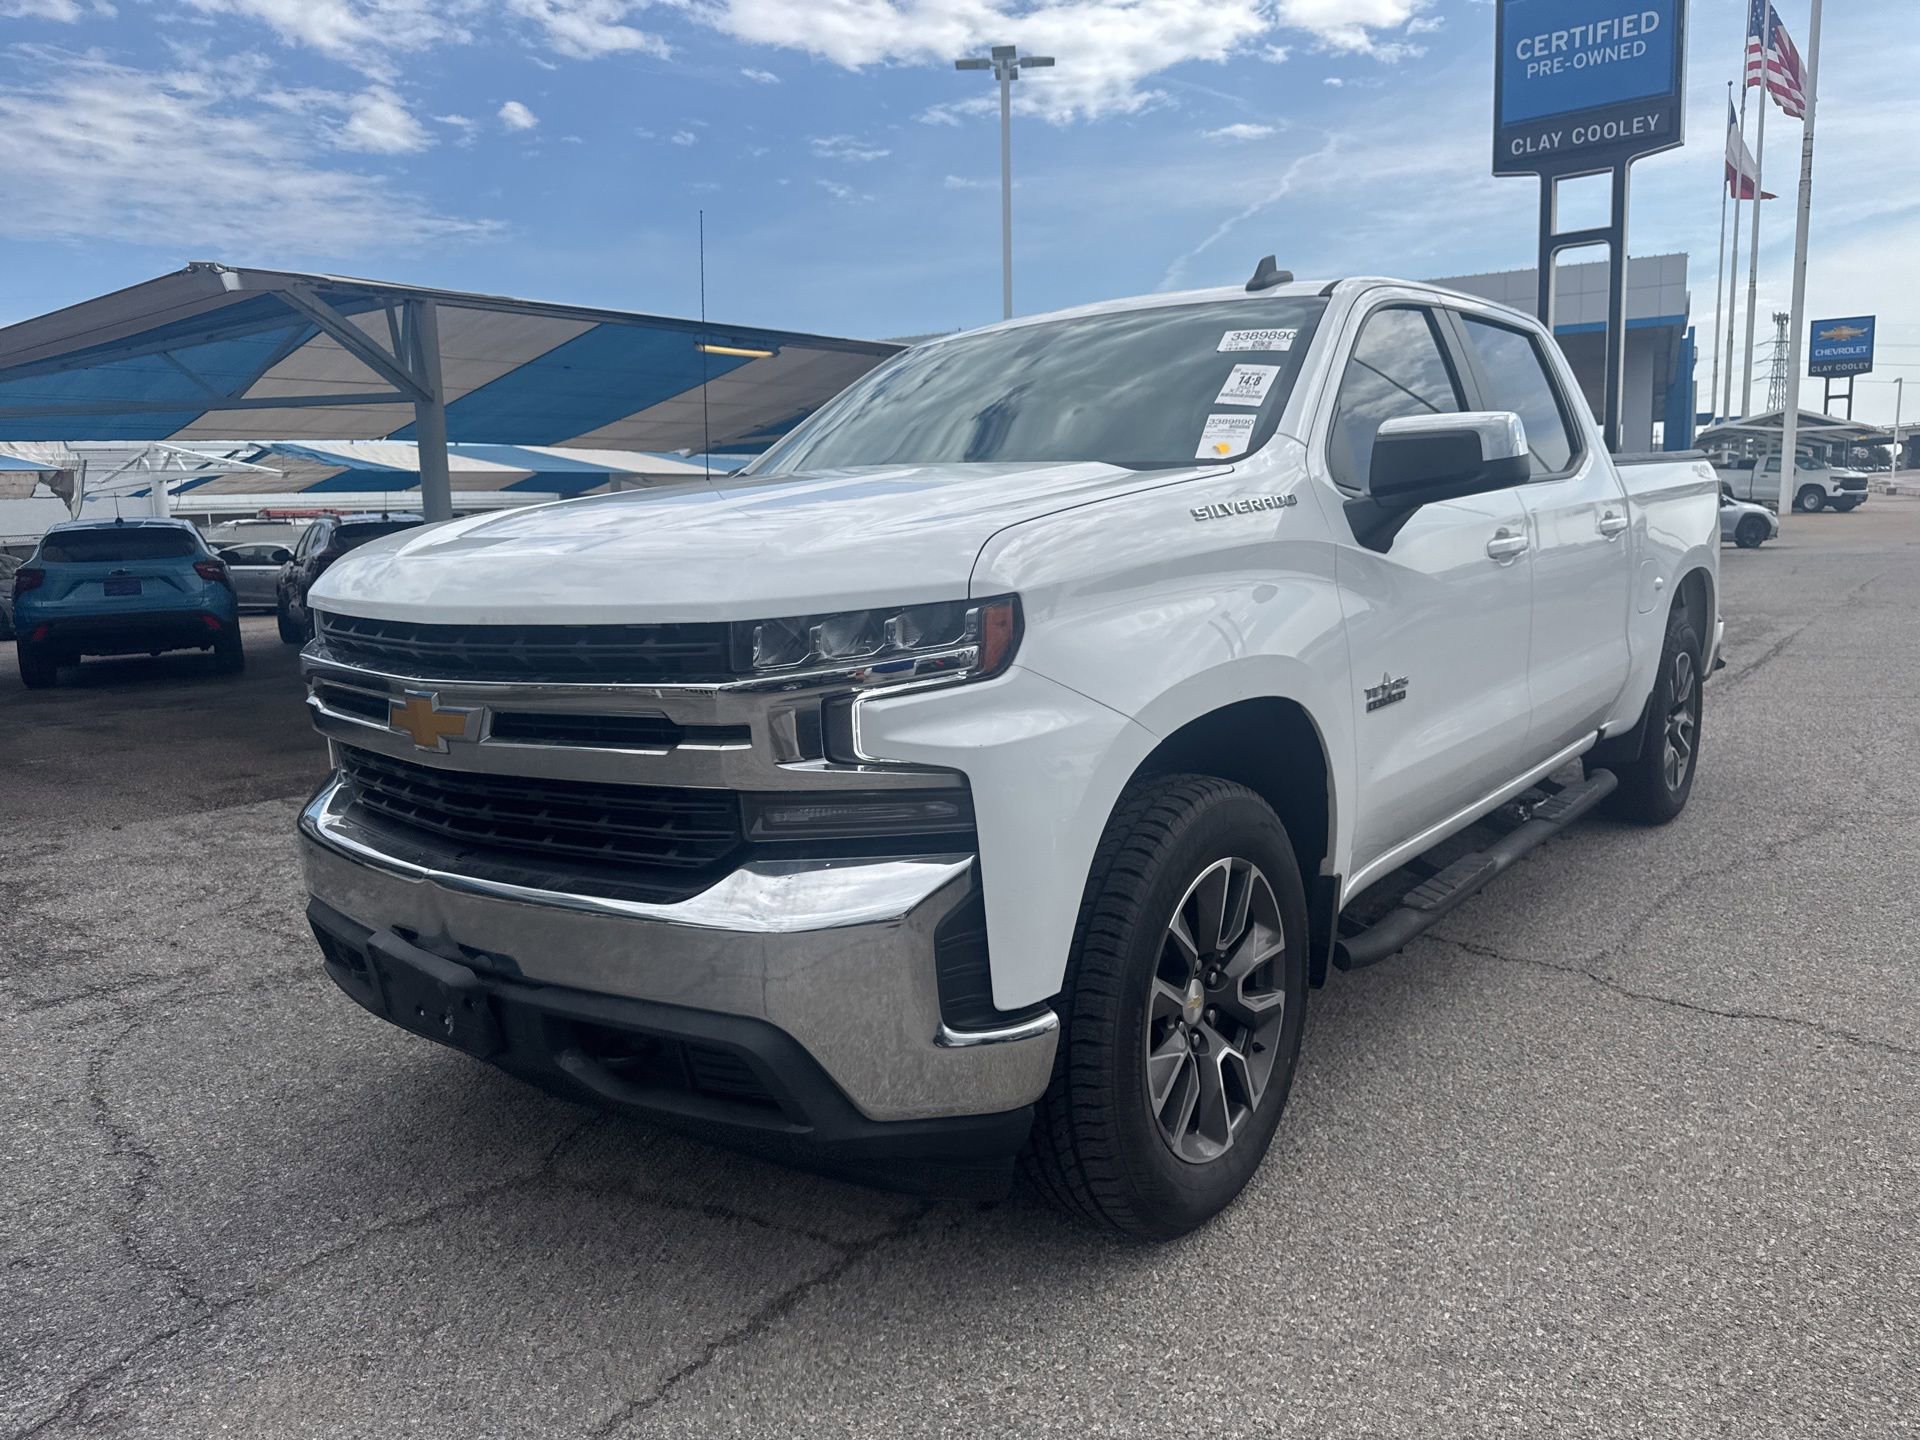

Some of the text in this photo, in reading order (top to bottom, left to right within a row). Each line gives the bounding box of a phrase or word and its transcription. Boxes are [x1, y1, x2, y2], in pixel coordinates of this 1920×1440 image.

[1515, 10, 1661, 61] CERTIFIED
[1526, 40, 1648, 80] PRE-OWNED
[1510, 113, 1661, 156] CLAY COOLEY
[1811, 362, 1870, 373] CLAY COOLEY
[1814, 345, 1868, 357] CHEVROLET
[1190, 493, 1298, 522] SILVERADO
